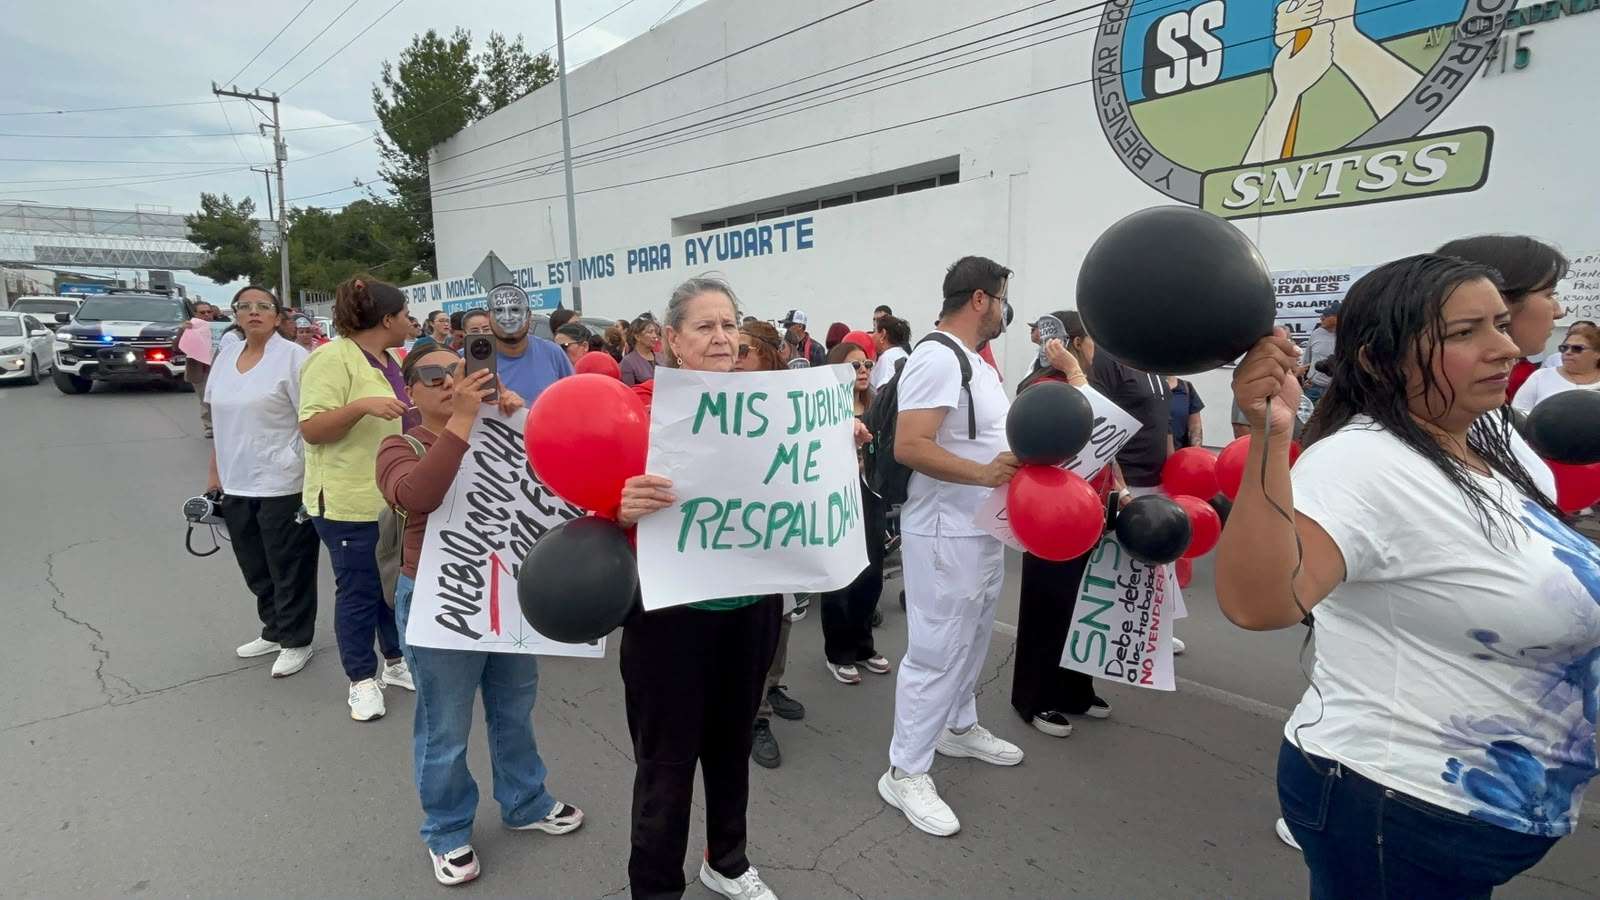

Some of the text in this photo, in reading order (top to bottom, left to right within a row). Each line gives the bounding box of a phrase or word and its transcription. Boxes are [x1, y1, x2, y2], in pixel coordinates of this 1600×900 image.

[1098, 45, 1154, 170] BIENESTAR
[1155, 168, 1174, 190] Y
[1221, 142, 1460, 210] SNTSS
[412, 286, 427, 304] POR
[431, 283, 442, 301] UN
[446, 276, 483, 299] MOMEN
[548, 253, 615, 285] ESTMOS
[627, 243, 672, 274] PARA
[685, 217, 814, 266] AYUDARTE
[1278, 274, 1351, 285] CONDICIONES
[1274, 282, 1340, 294] RALES
[691, 391, 769, 438] MIS
[762, 439, 822, 485] ME
[434, 417, 527, 641] PUEBLO ESCUCHA
[676, 479, 860, 553] RESPALDAN
[1104, 619, 1134, 678] Debe
[1140, 658, 1154, 686] NO
